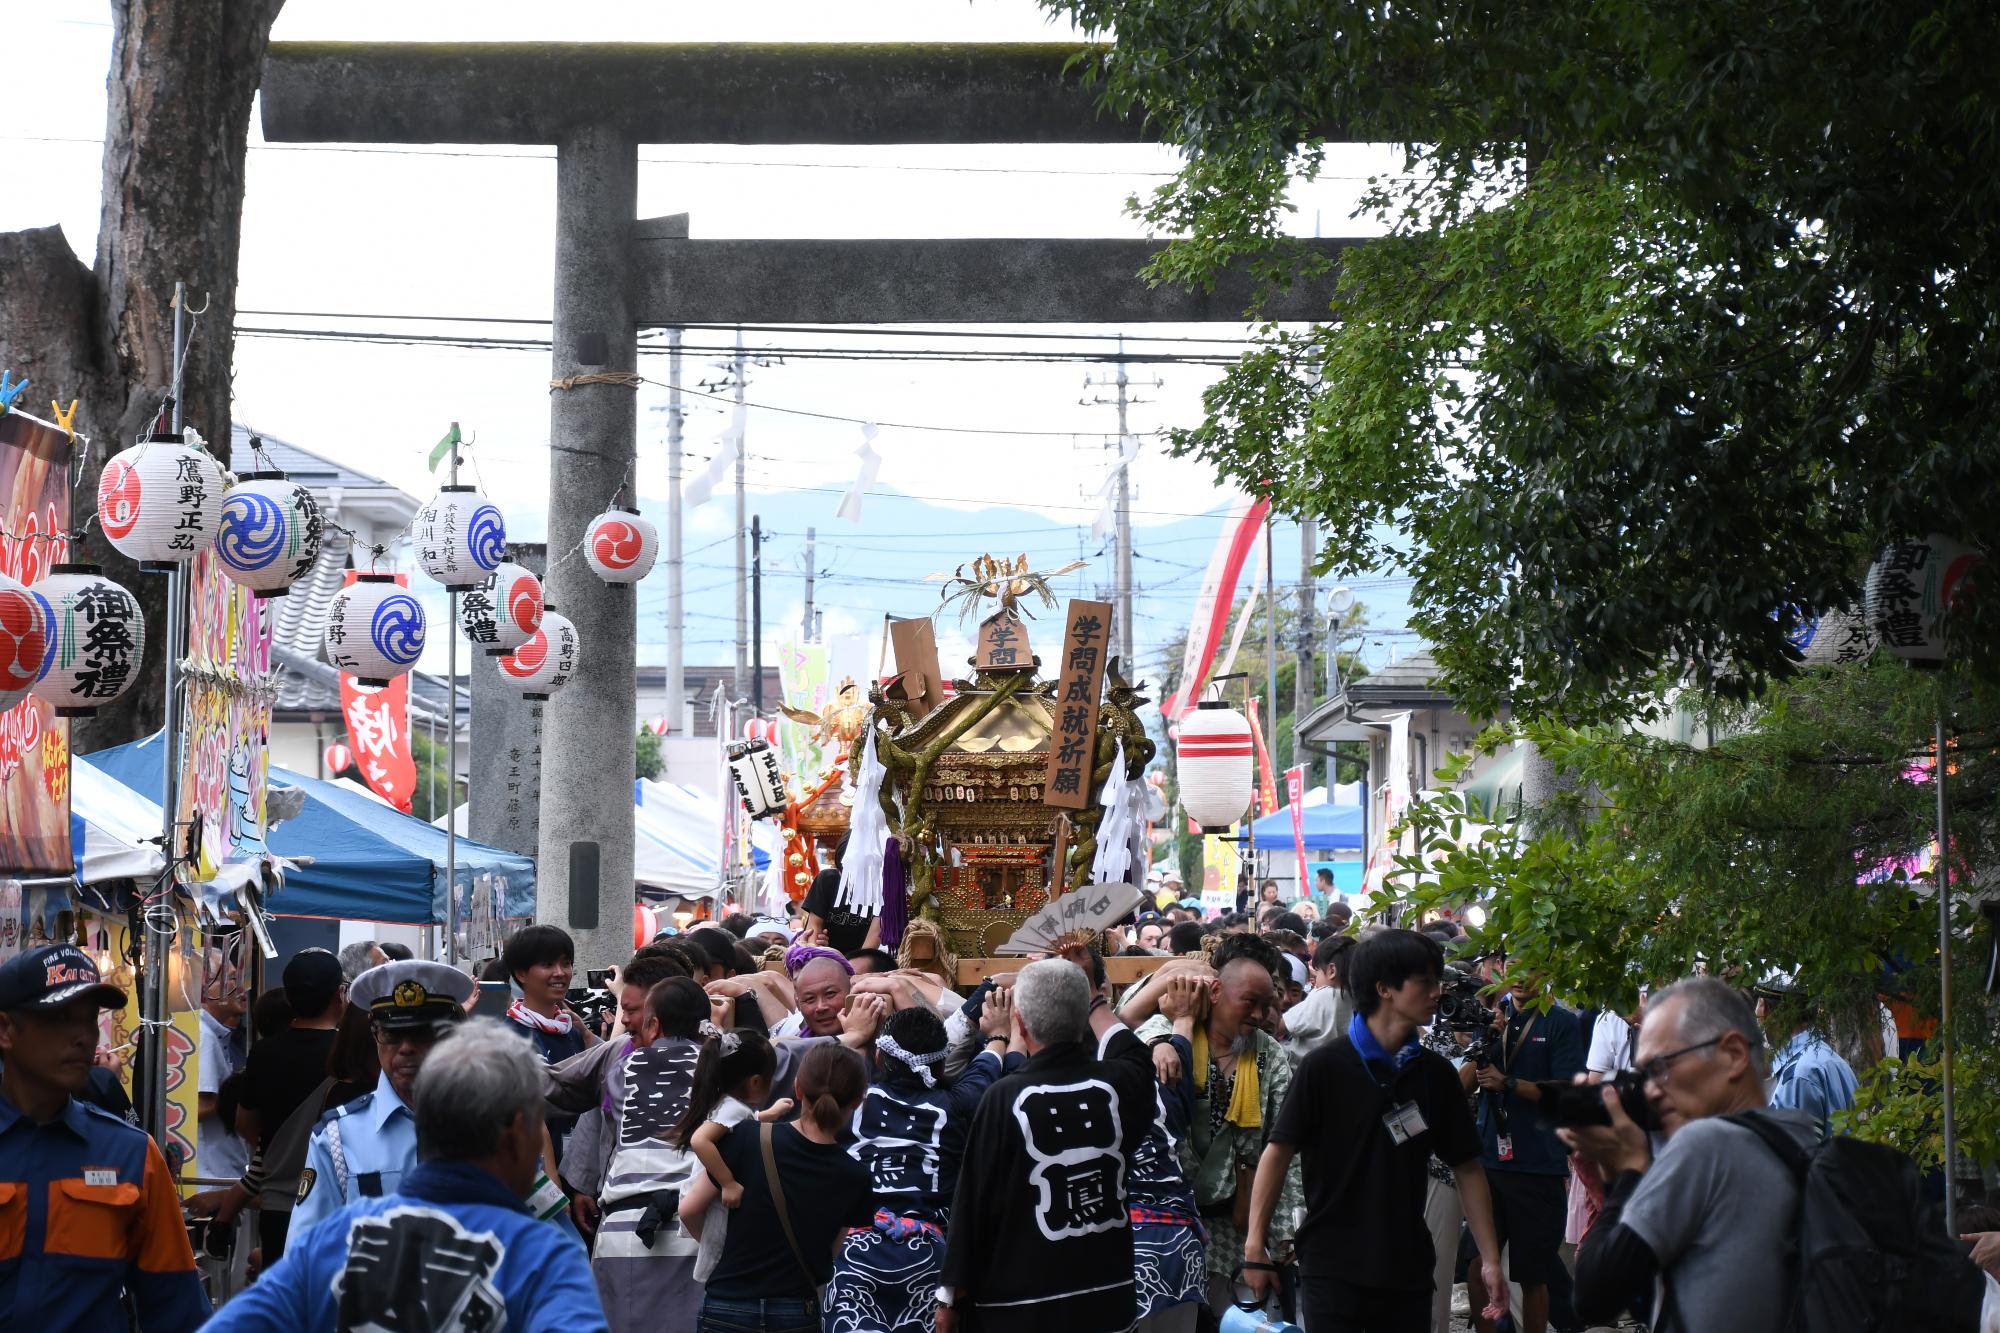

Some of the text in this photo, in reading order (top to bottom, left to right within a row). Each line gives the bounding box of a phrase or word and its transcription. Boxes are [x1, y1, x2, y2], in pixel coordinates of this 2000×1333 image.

[1050, 615, 1103, 797] 学問成就祈願
[43, 952, 60, 968] FIRE
